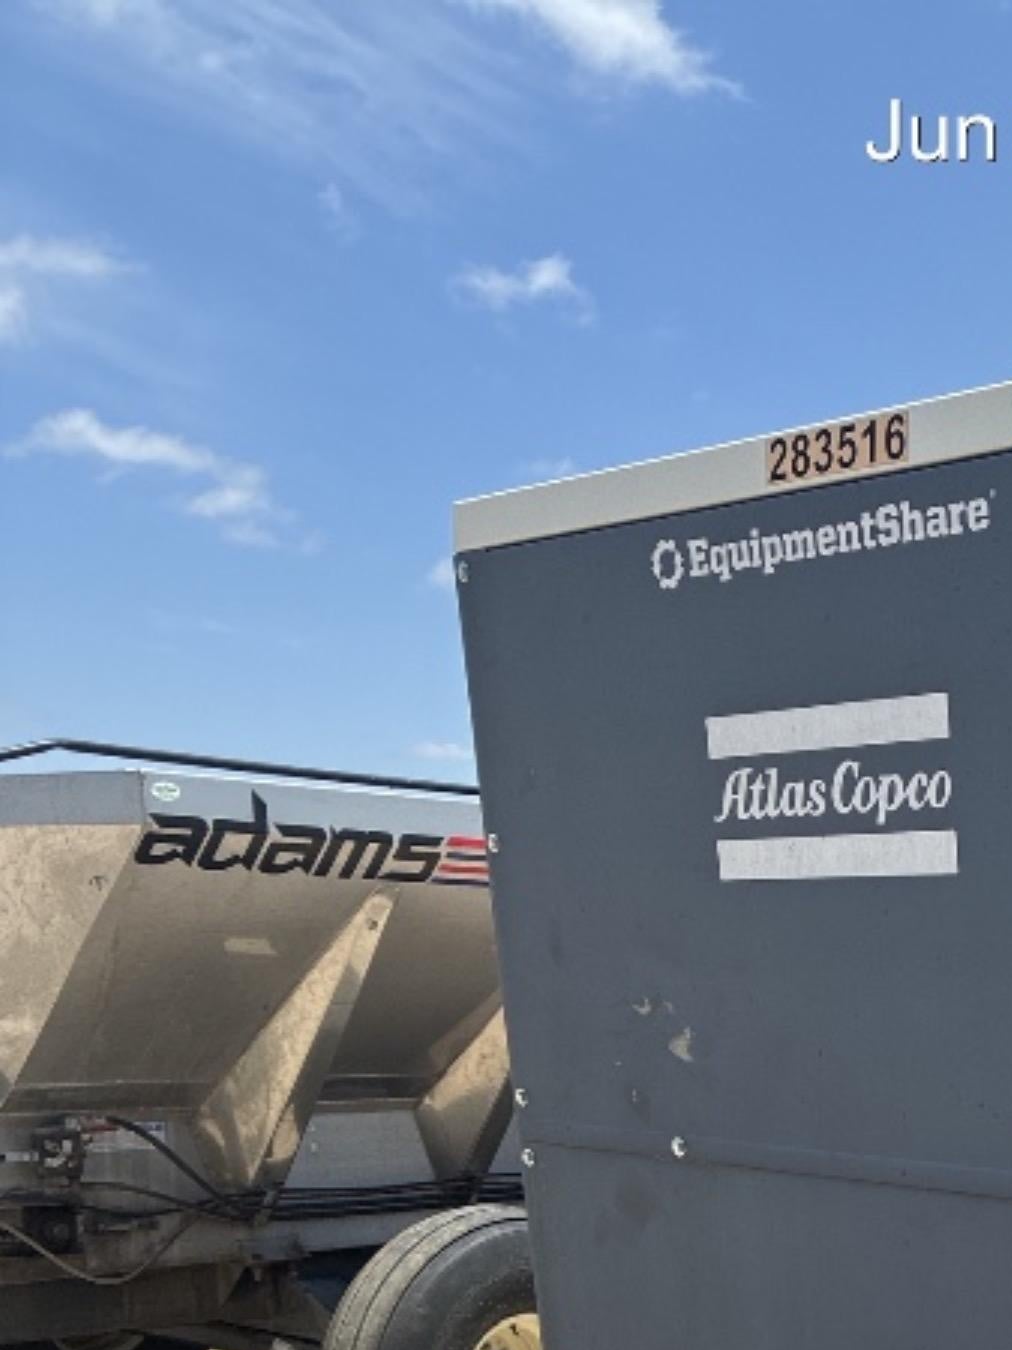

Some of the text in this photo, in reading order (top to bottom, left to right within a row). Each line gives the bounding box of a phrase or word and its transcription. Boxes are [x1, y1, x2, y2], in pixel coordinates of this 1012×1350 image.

[768, 413, 907, 484] 283516
[687, 494, 991, 583] EquipmentShare
[714, 758, 953, 825] Atlas Copco
[134, 788, 443, 883] adams
